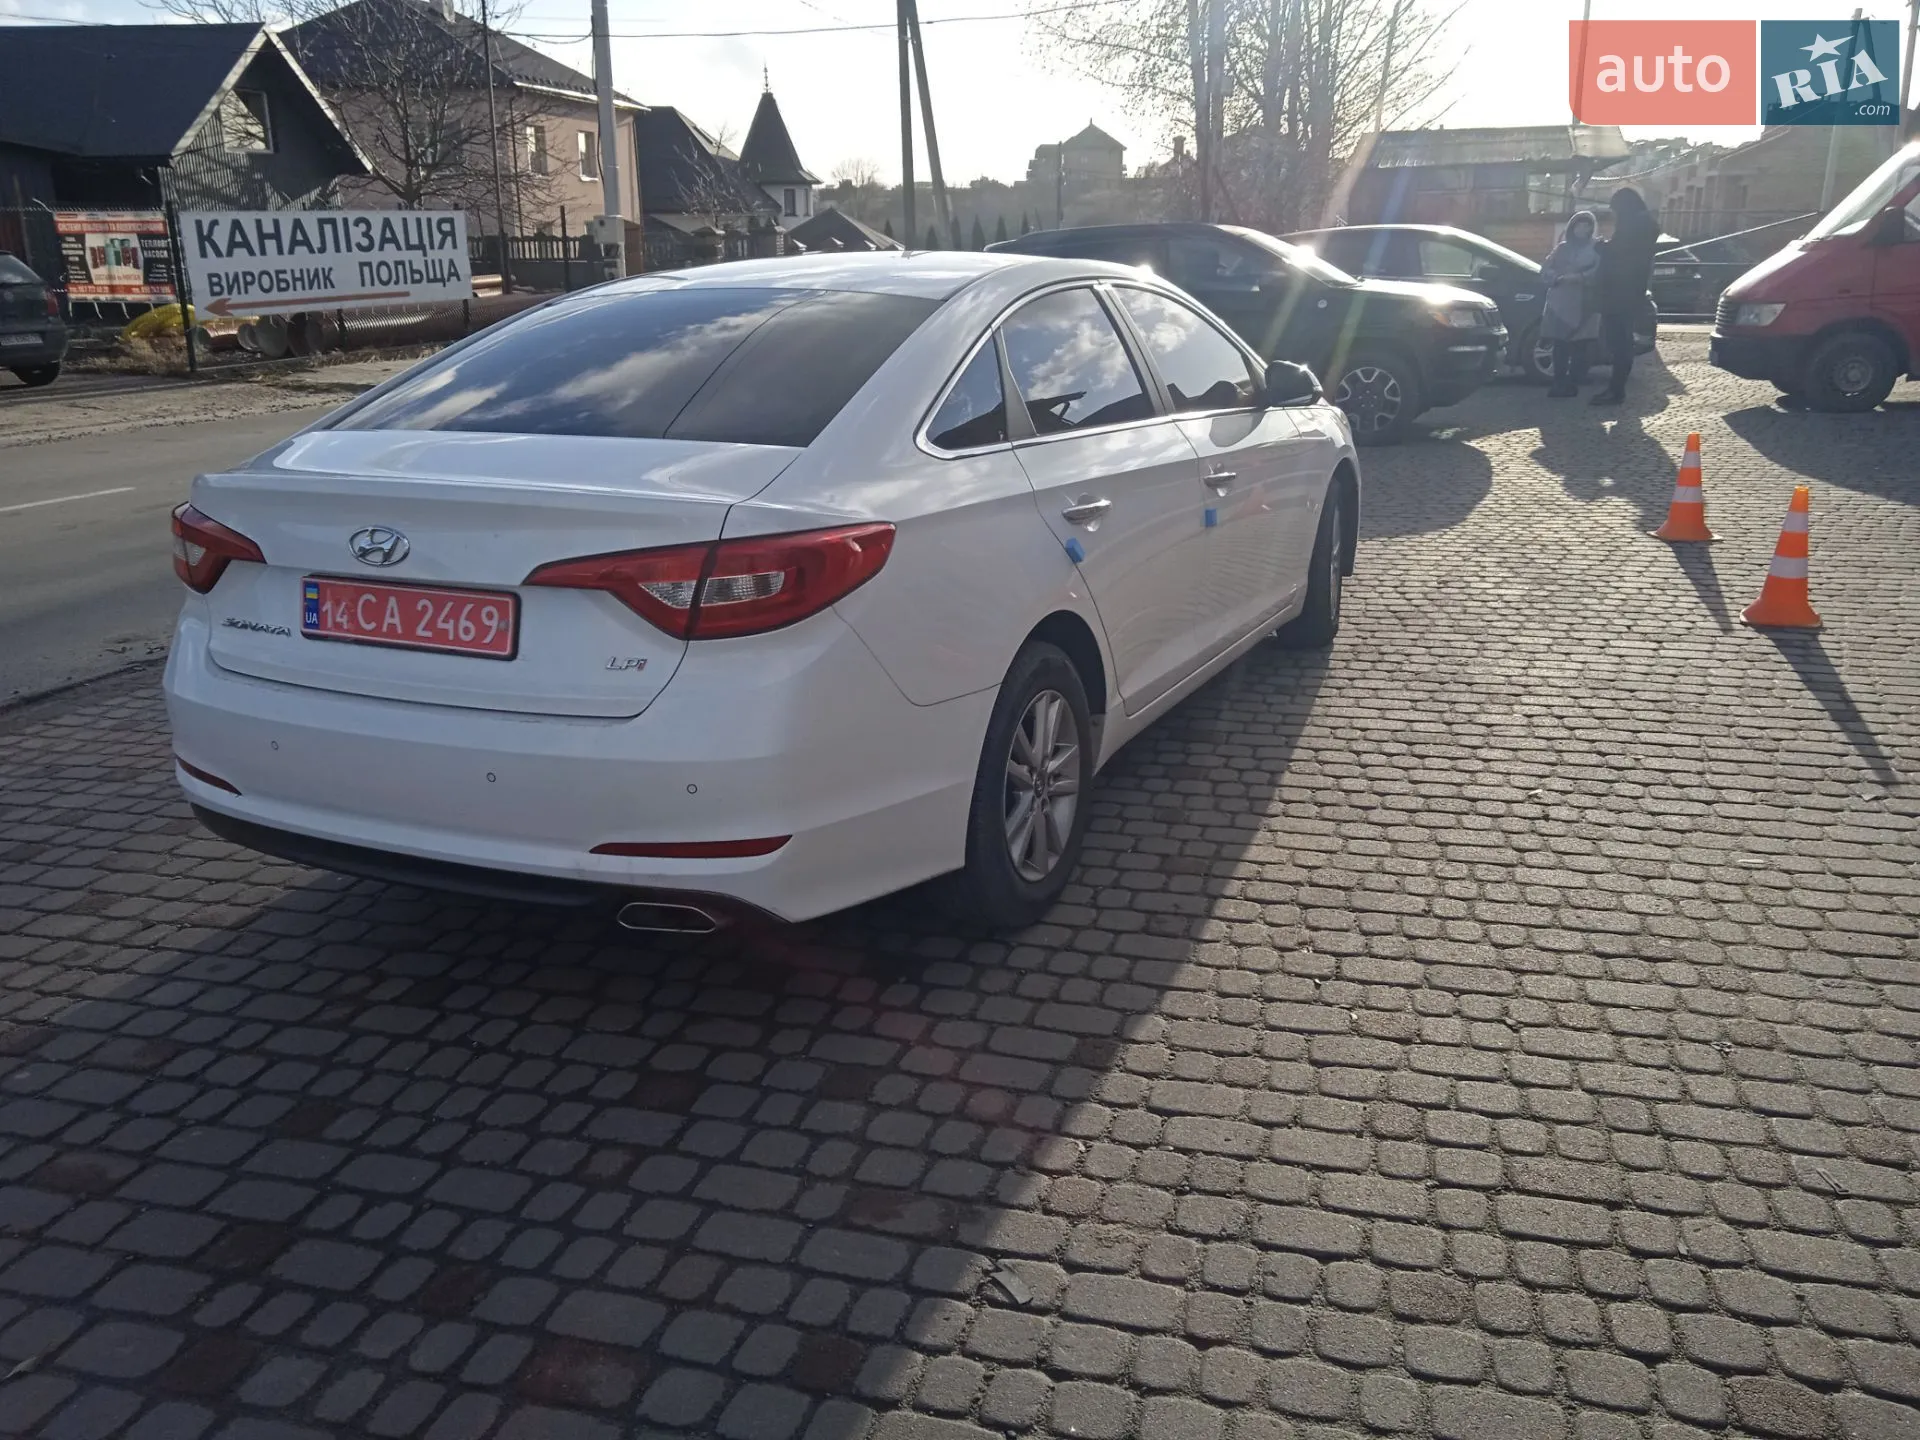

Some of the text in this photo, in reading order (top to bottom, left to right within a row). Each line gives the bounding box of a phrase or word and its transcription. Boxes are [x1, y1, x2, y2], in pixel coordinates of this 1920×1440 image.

[194, 216, 459, 259] КАНАЛІЗАЦІЯ
[207, 257, 462, 298] ВИРОБНИК ПОЛЬЩА
[305, 611, 319, 625] UA
[415, 599, 500, 644] 2469
